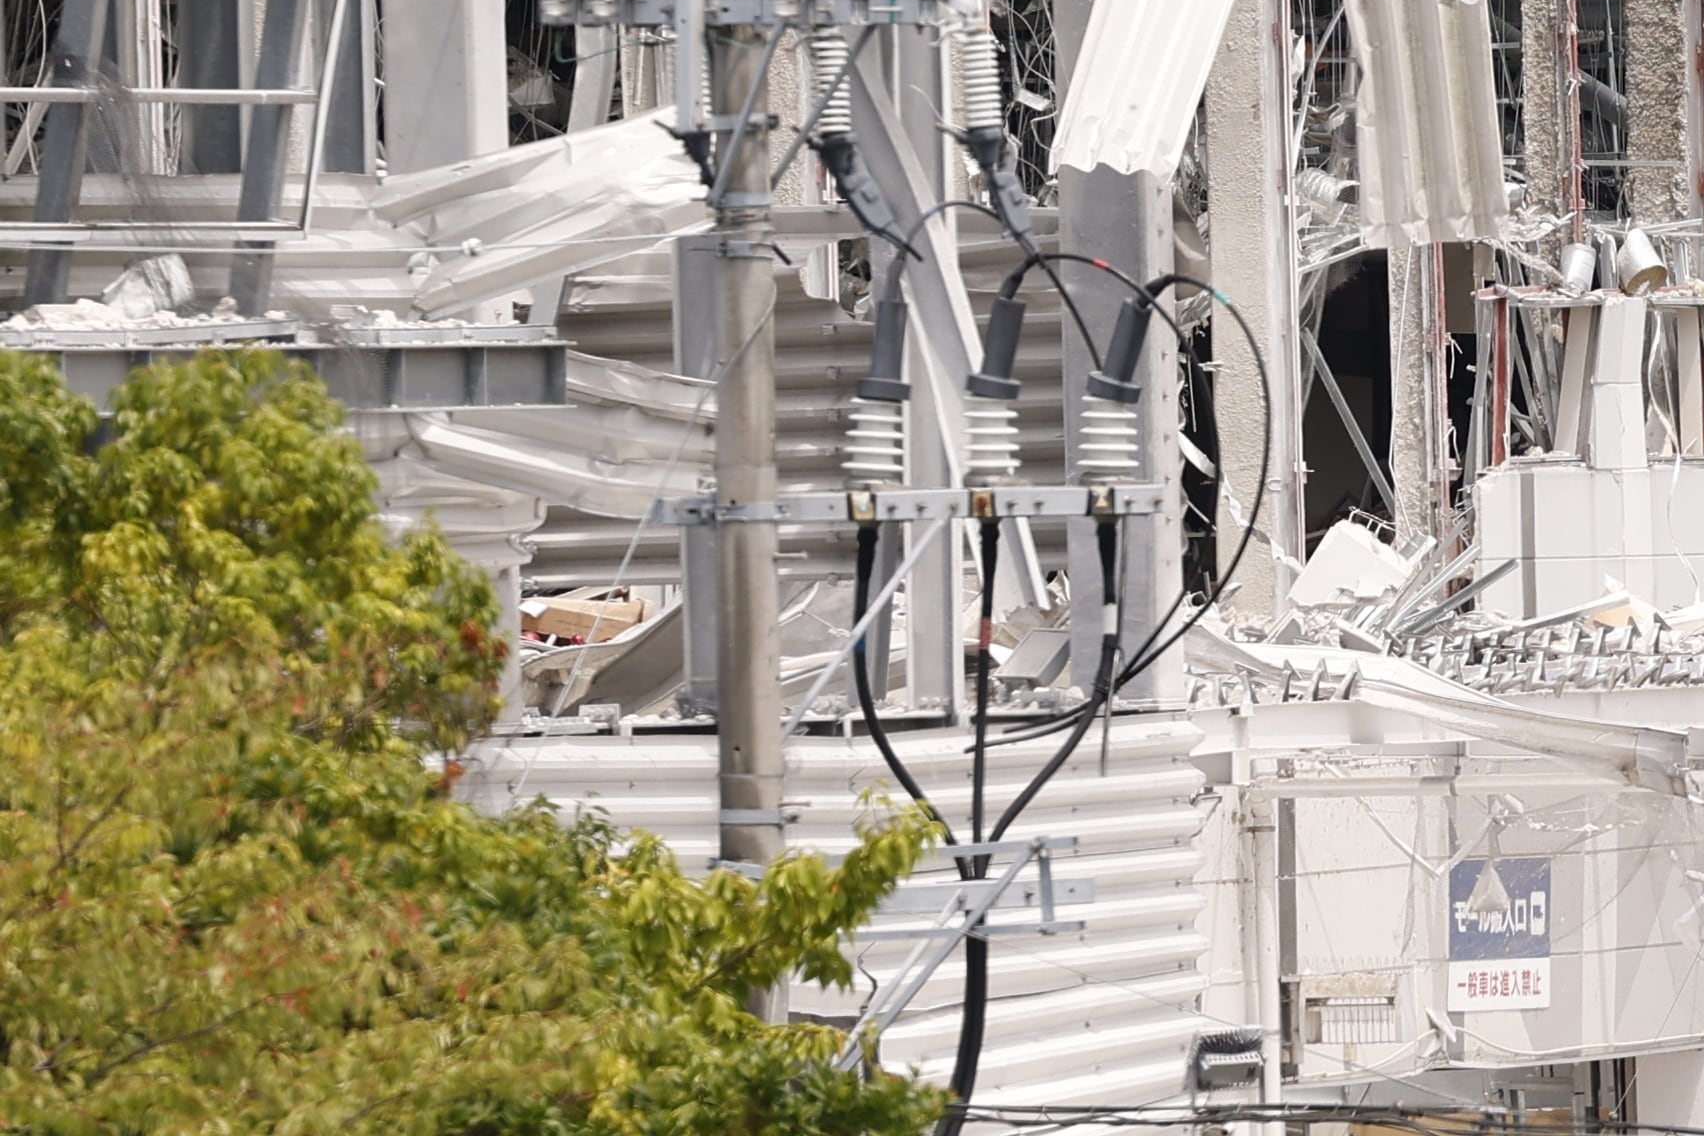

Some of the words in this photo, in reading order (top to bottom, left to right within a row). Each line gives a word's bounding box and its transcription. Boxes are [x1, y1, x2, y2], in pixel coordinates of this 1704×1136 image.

[1457, 969, 1541, 998] 一般車は進入禁止
